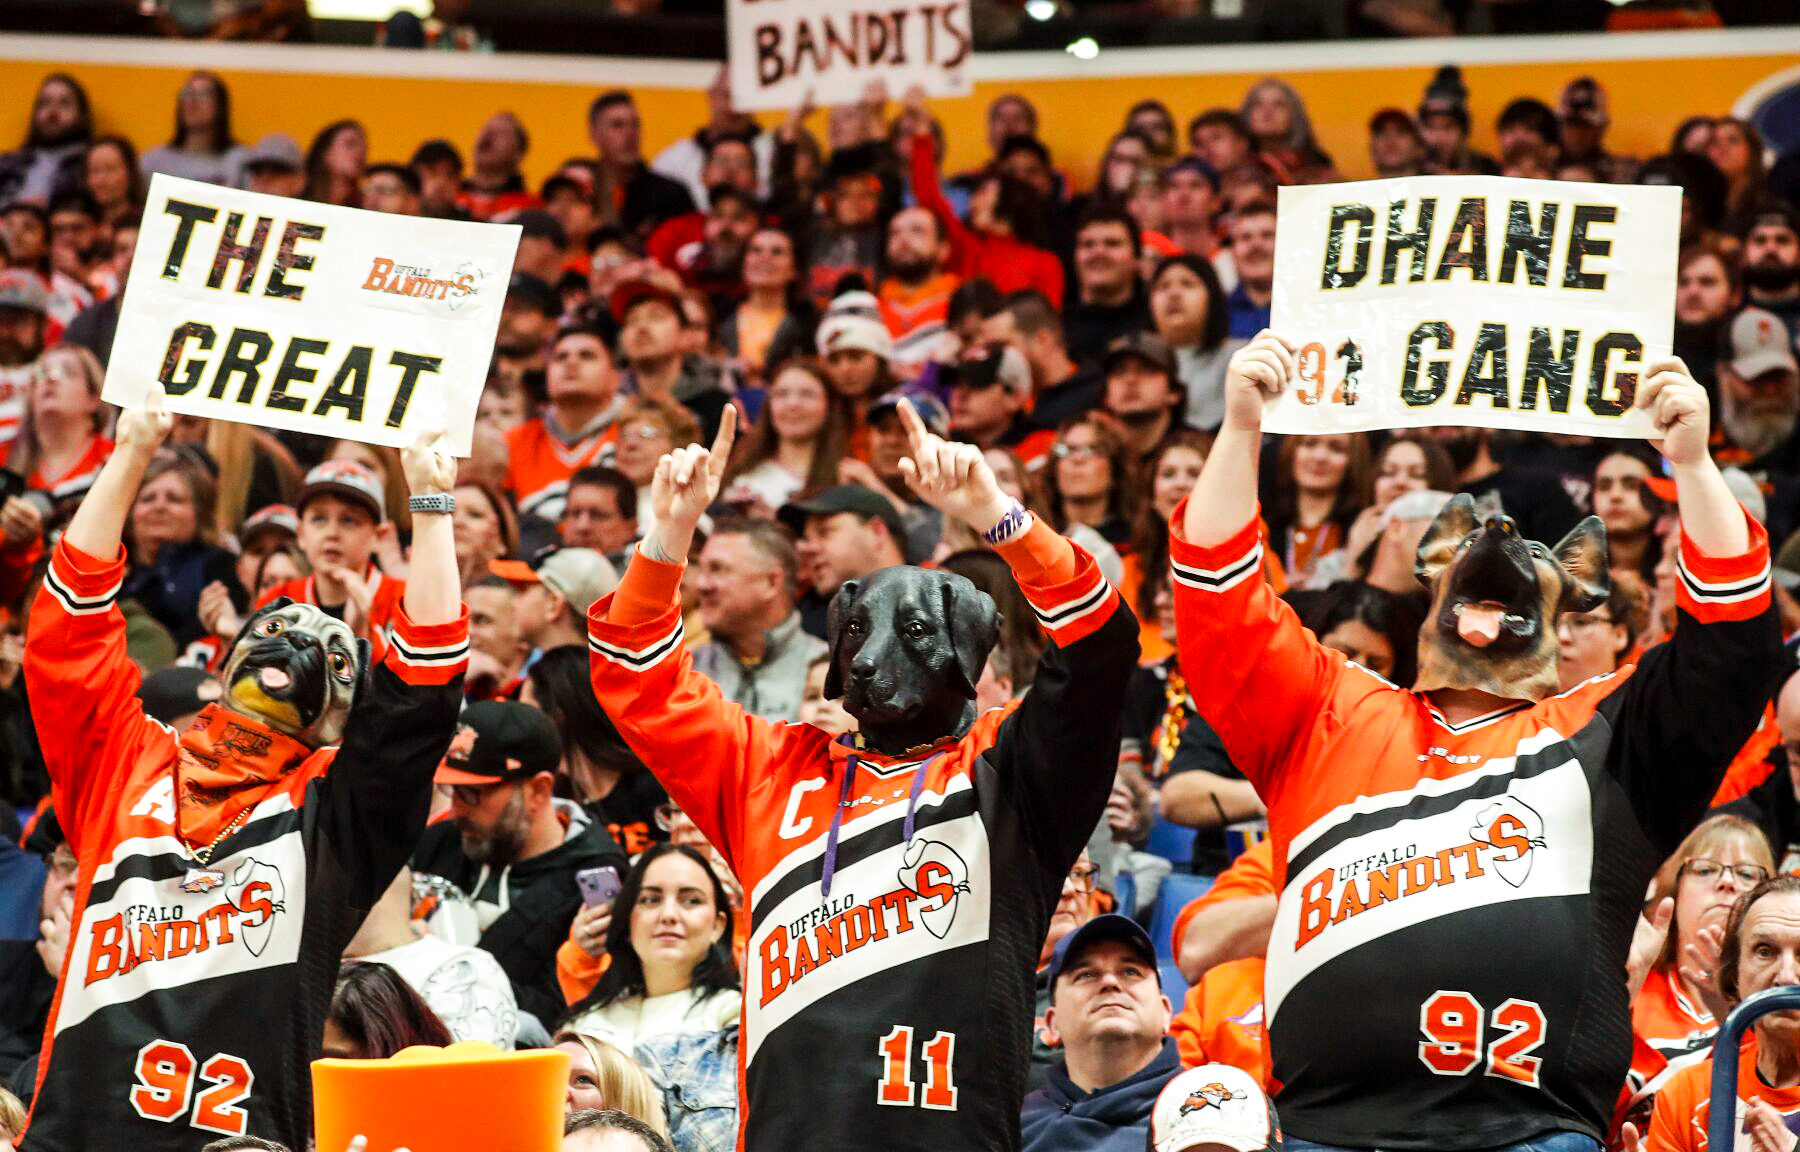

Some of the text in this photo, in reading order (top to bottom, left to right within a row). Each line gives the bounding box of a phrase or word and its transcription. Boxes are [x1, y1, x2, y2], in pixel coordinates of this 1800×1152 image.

[756, 5, 970, 86] BANDITS
[161, 197, 327, 302] THE
[360, 257, 475, 301] BANDITS
[1320, 196, 1620, 292] DHANE
[157, 321, 444, 429] GREAT
[1296, 320, 1645, 418] 92 GANG
[778, 776, 827, 840] C
[1295, 813, 1530, 953] BANDITS
[84, 880, 273, 988] BANDITS
[759, 860, 955, 1010] BANDITS
[129, 1038, 255, 1137] 92
[877, 1024, 959, 1112] 11
[1418, 990, 1548, 1089] 92
